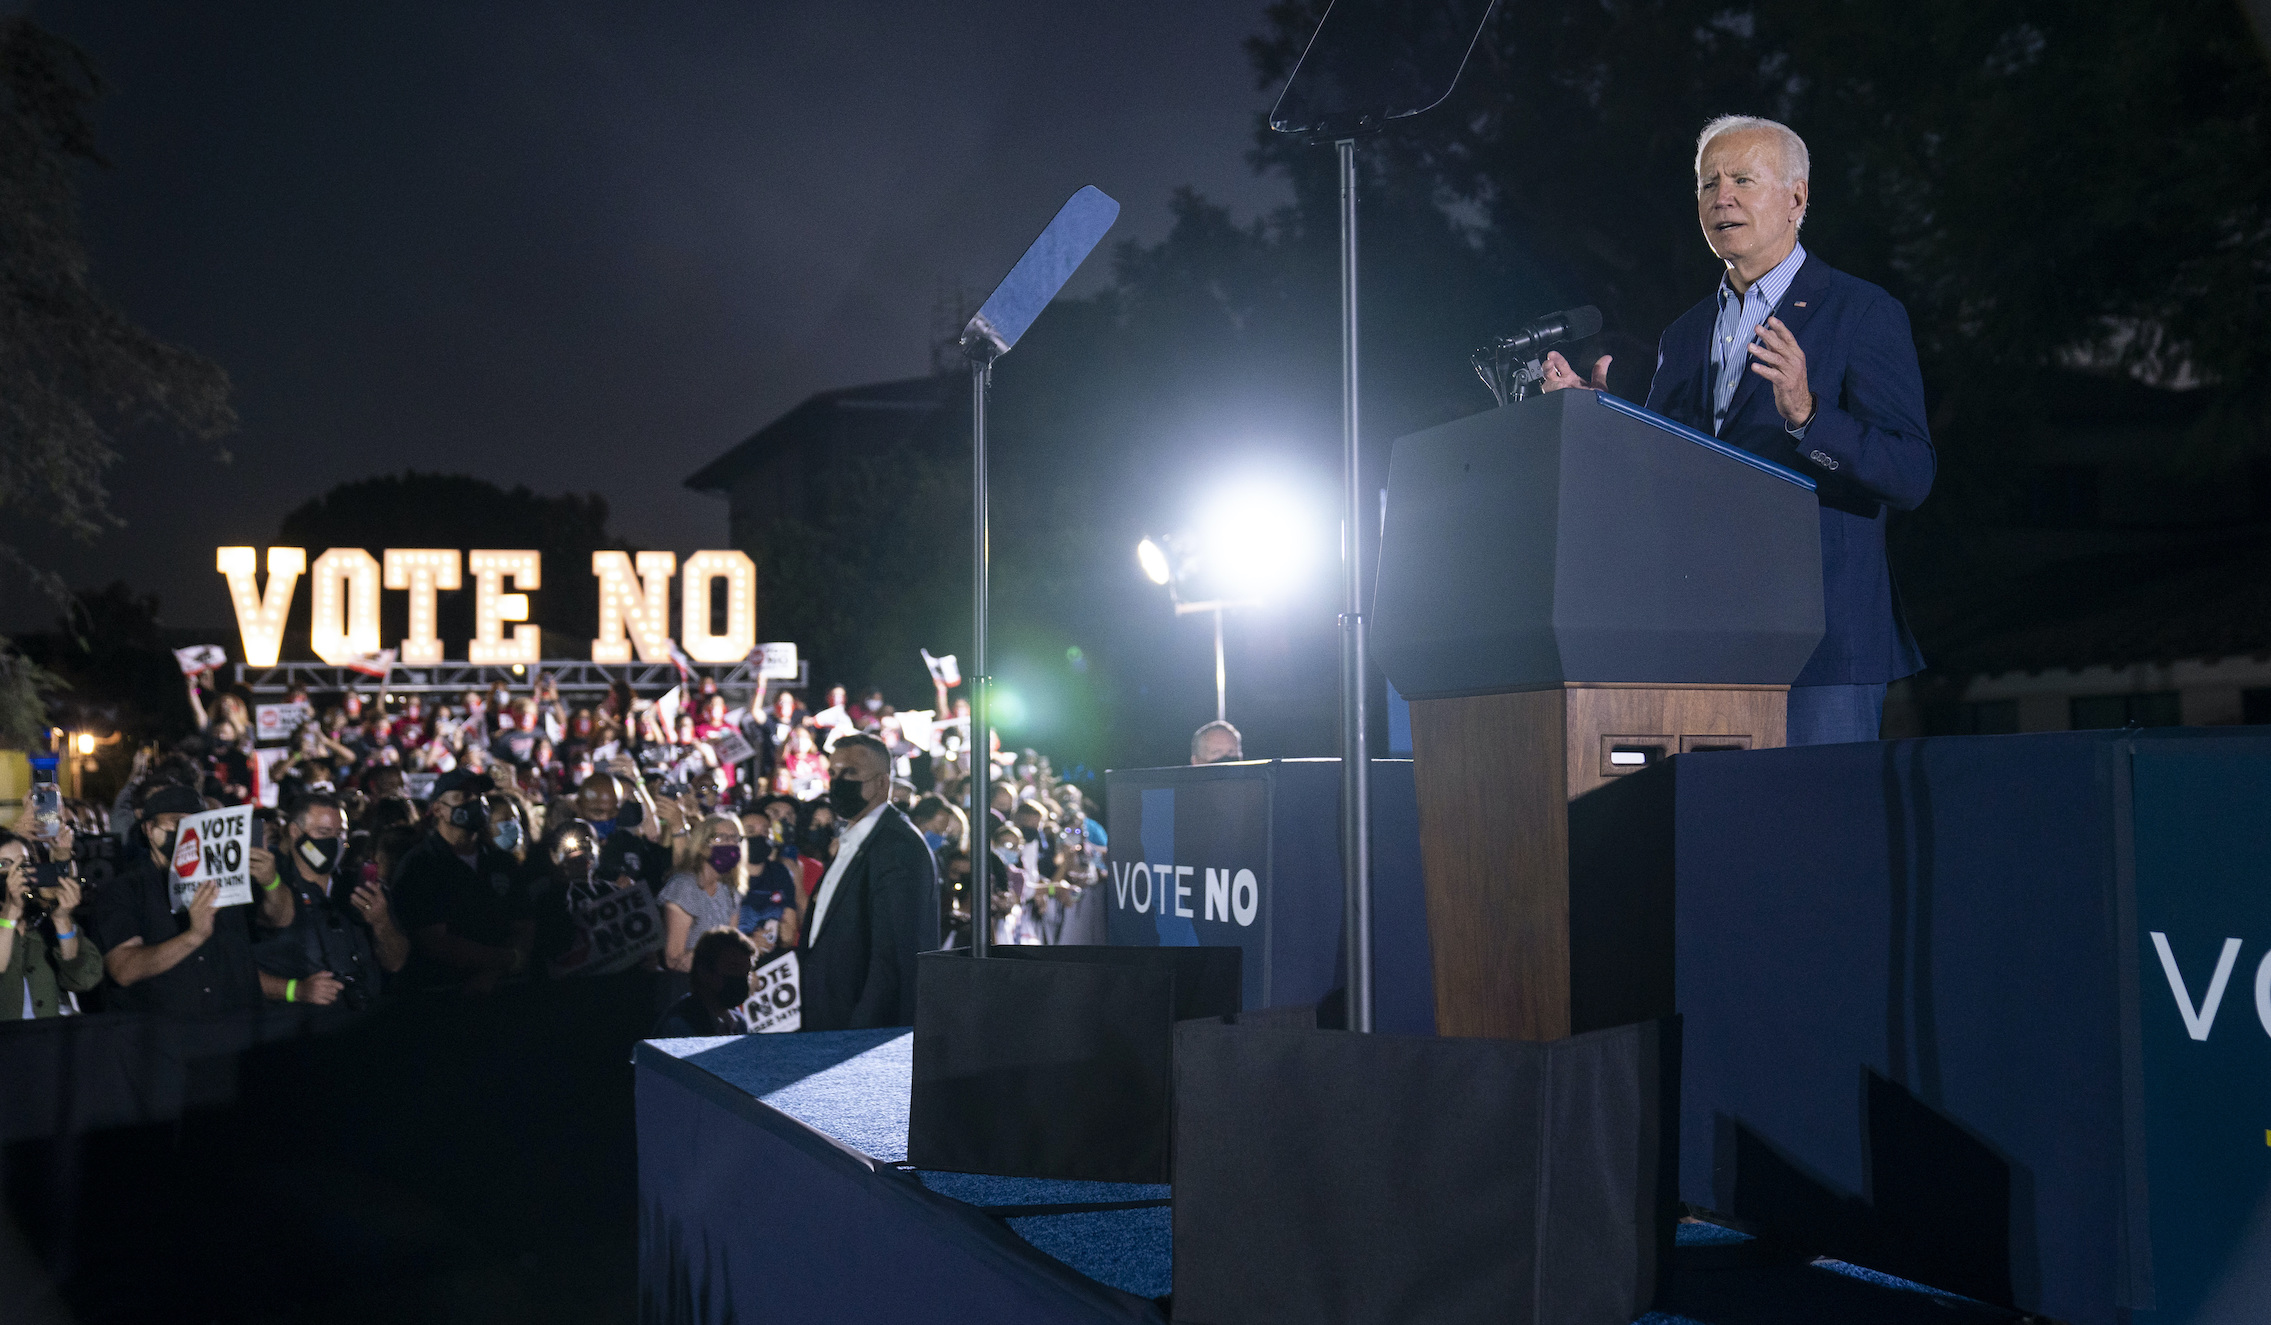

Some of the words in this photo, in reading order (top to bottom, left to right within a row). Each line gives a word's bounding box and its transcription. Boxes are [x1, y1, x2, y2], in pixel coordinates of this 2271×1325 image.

[216, 546, 541, 667] VOTE
[592, 550, 756, 663] NO
[202, 814, 244, 840] VOTE
[204, 839, 242, 876] NO
[582, 890, 646, 927] VOTE
[1112, 861, 1194, 918] VOTE
[1205, 868, 1258, 926] NO
[593, 911, 653, 953] NO
[747, 983, 796, 1023] NO
